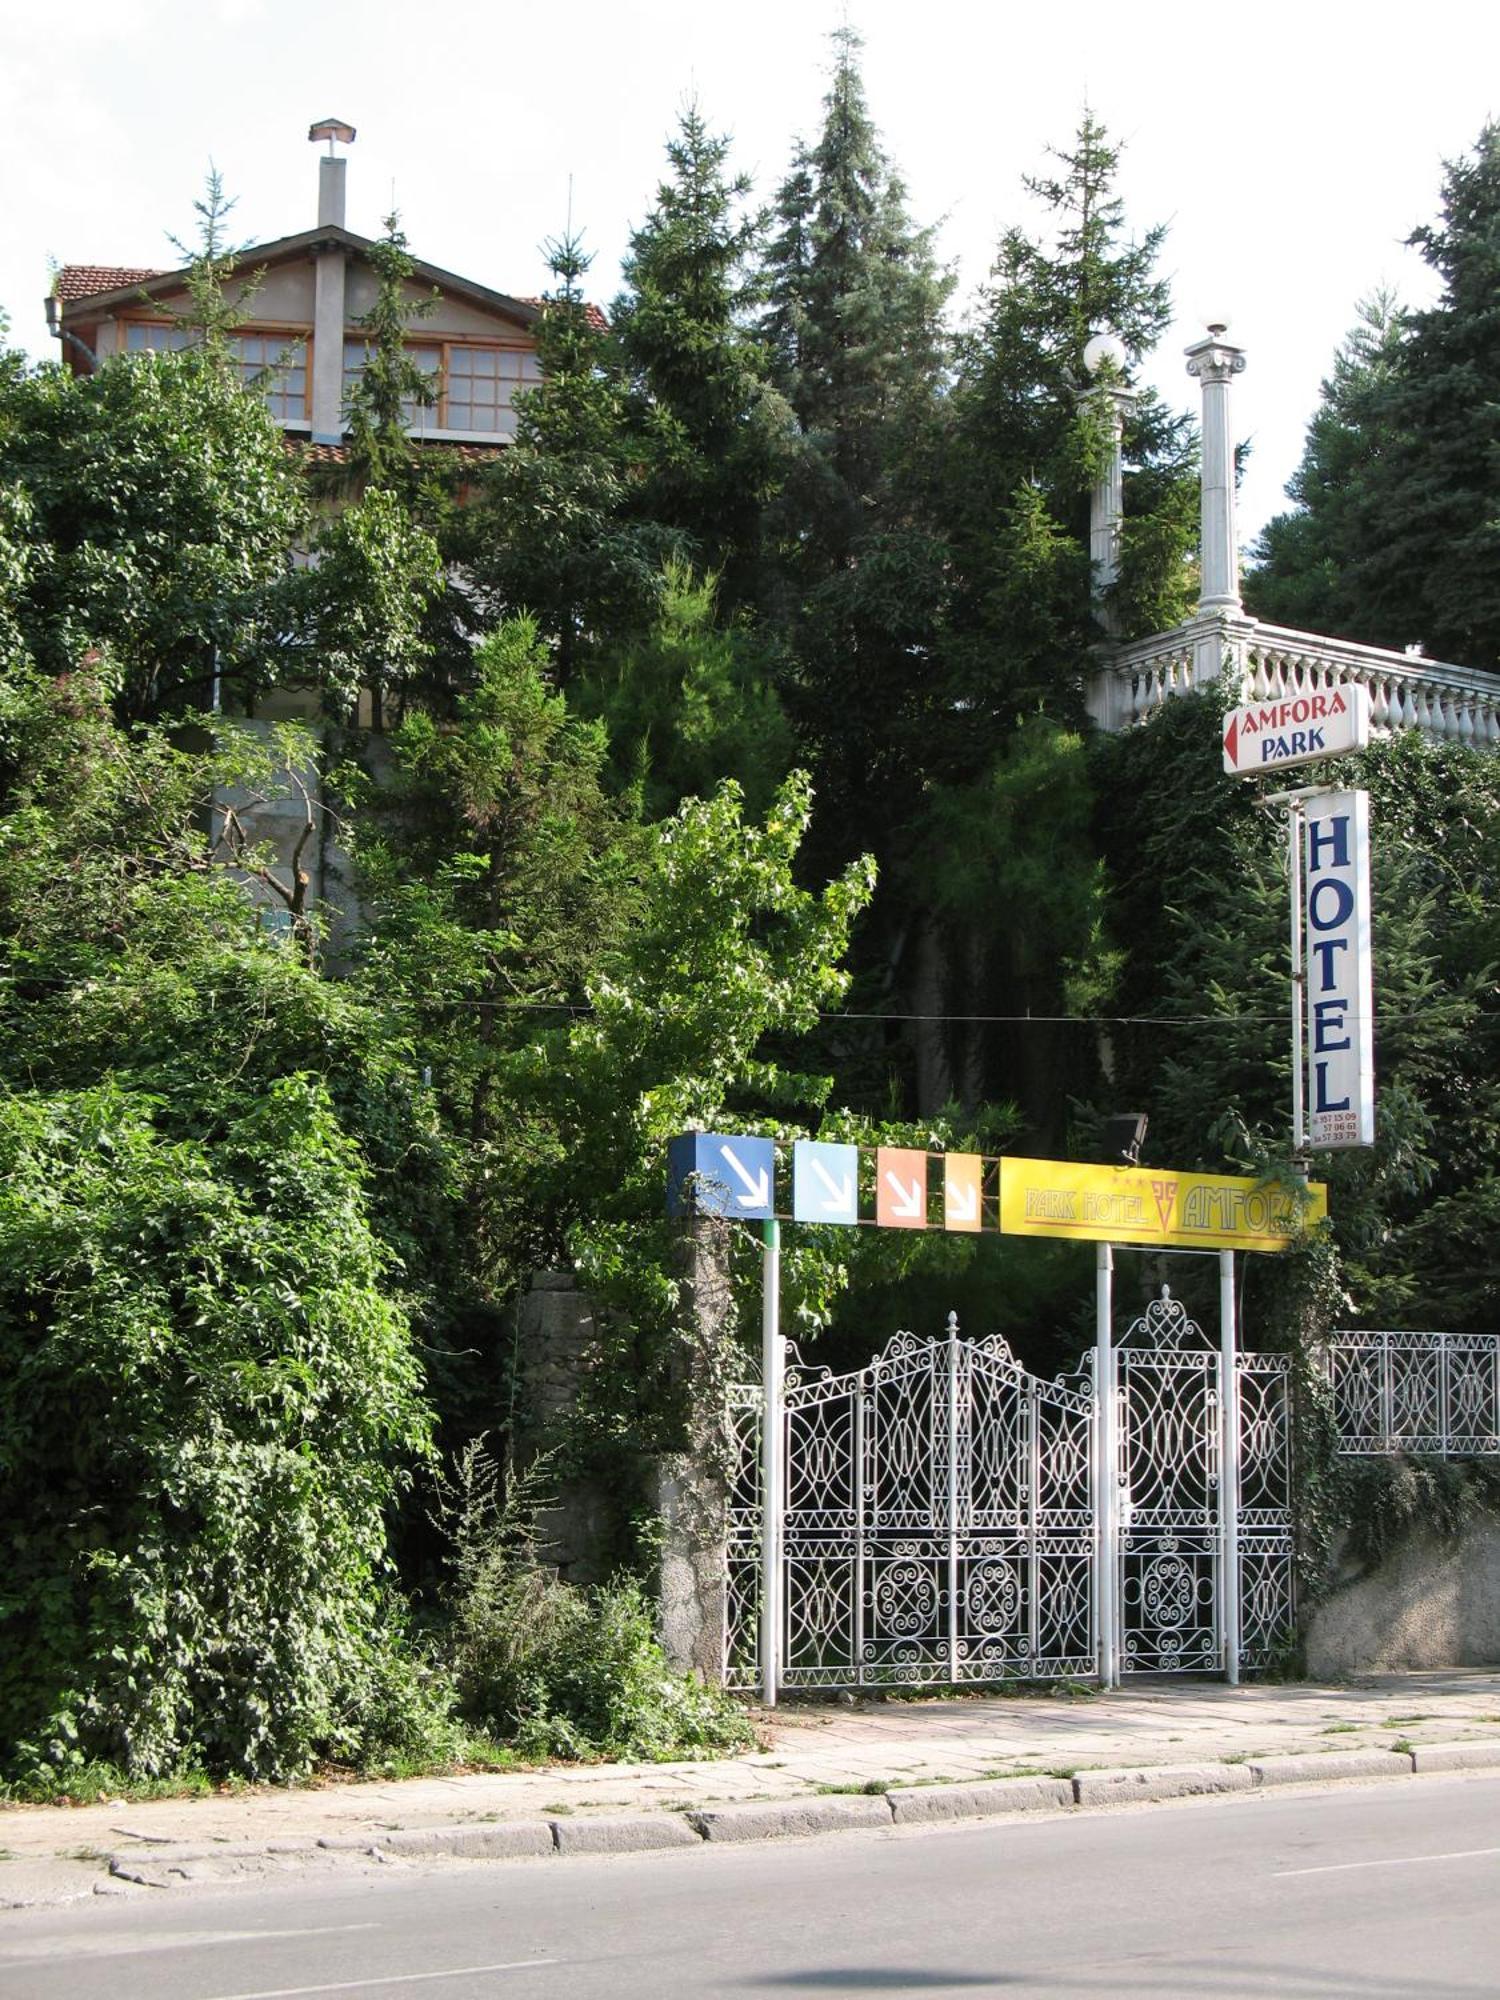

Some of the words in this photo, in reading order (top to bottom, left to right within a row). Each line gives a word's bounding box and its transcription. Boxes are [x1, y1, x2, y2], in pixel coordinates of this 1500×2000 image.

[1241, 691, 1346, 736] AMFORA
[1262, 726, 1325, 762] PARK
[1309, 816, 1354, 1113] HOTEL
[1025, 1187, 1076, 1219] PARK
[1083, 1191, 1149, 1224] HOTEL
[1183, 1185, 1303, 1235] AMFOR
